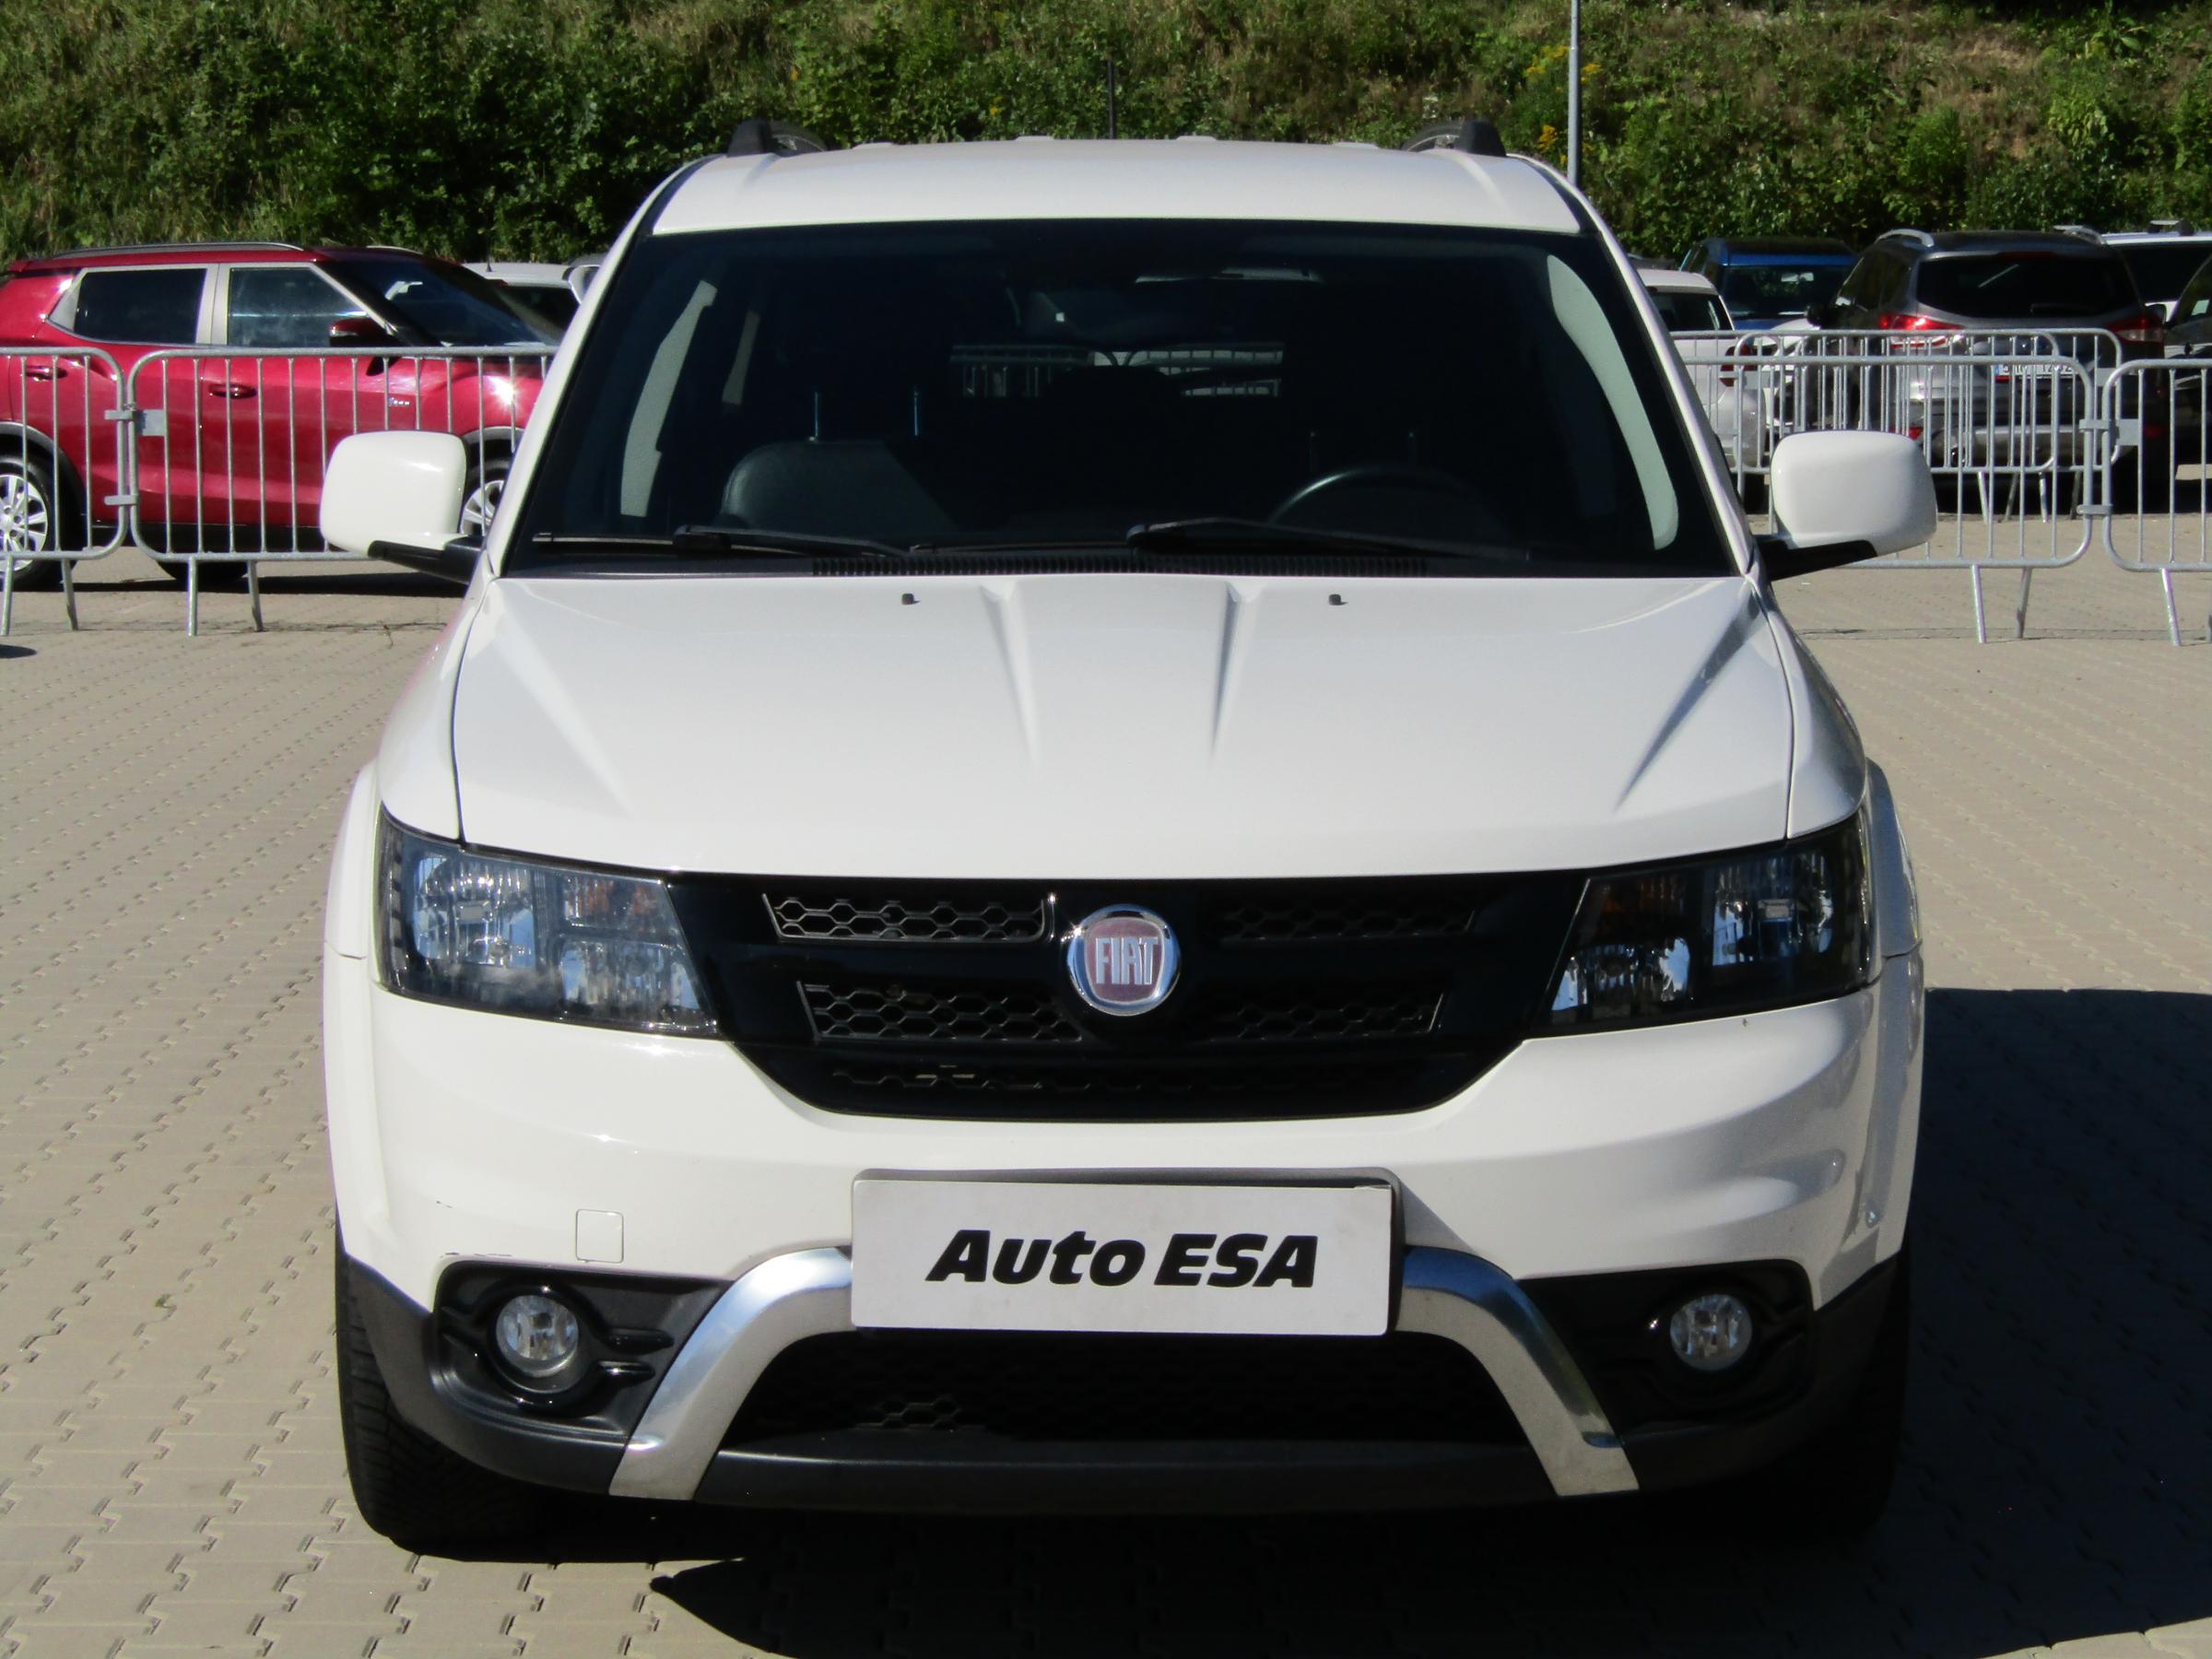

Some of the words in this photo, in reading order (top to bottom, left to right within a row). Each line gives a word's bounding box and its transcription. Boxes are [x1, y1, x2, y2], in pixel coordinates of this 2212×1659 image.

[1095, 936, 1159, 985] FIAT
[925, 1230, 1146, 1286] Auto
[1154, 1233, 1318, 1288] ESA
